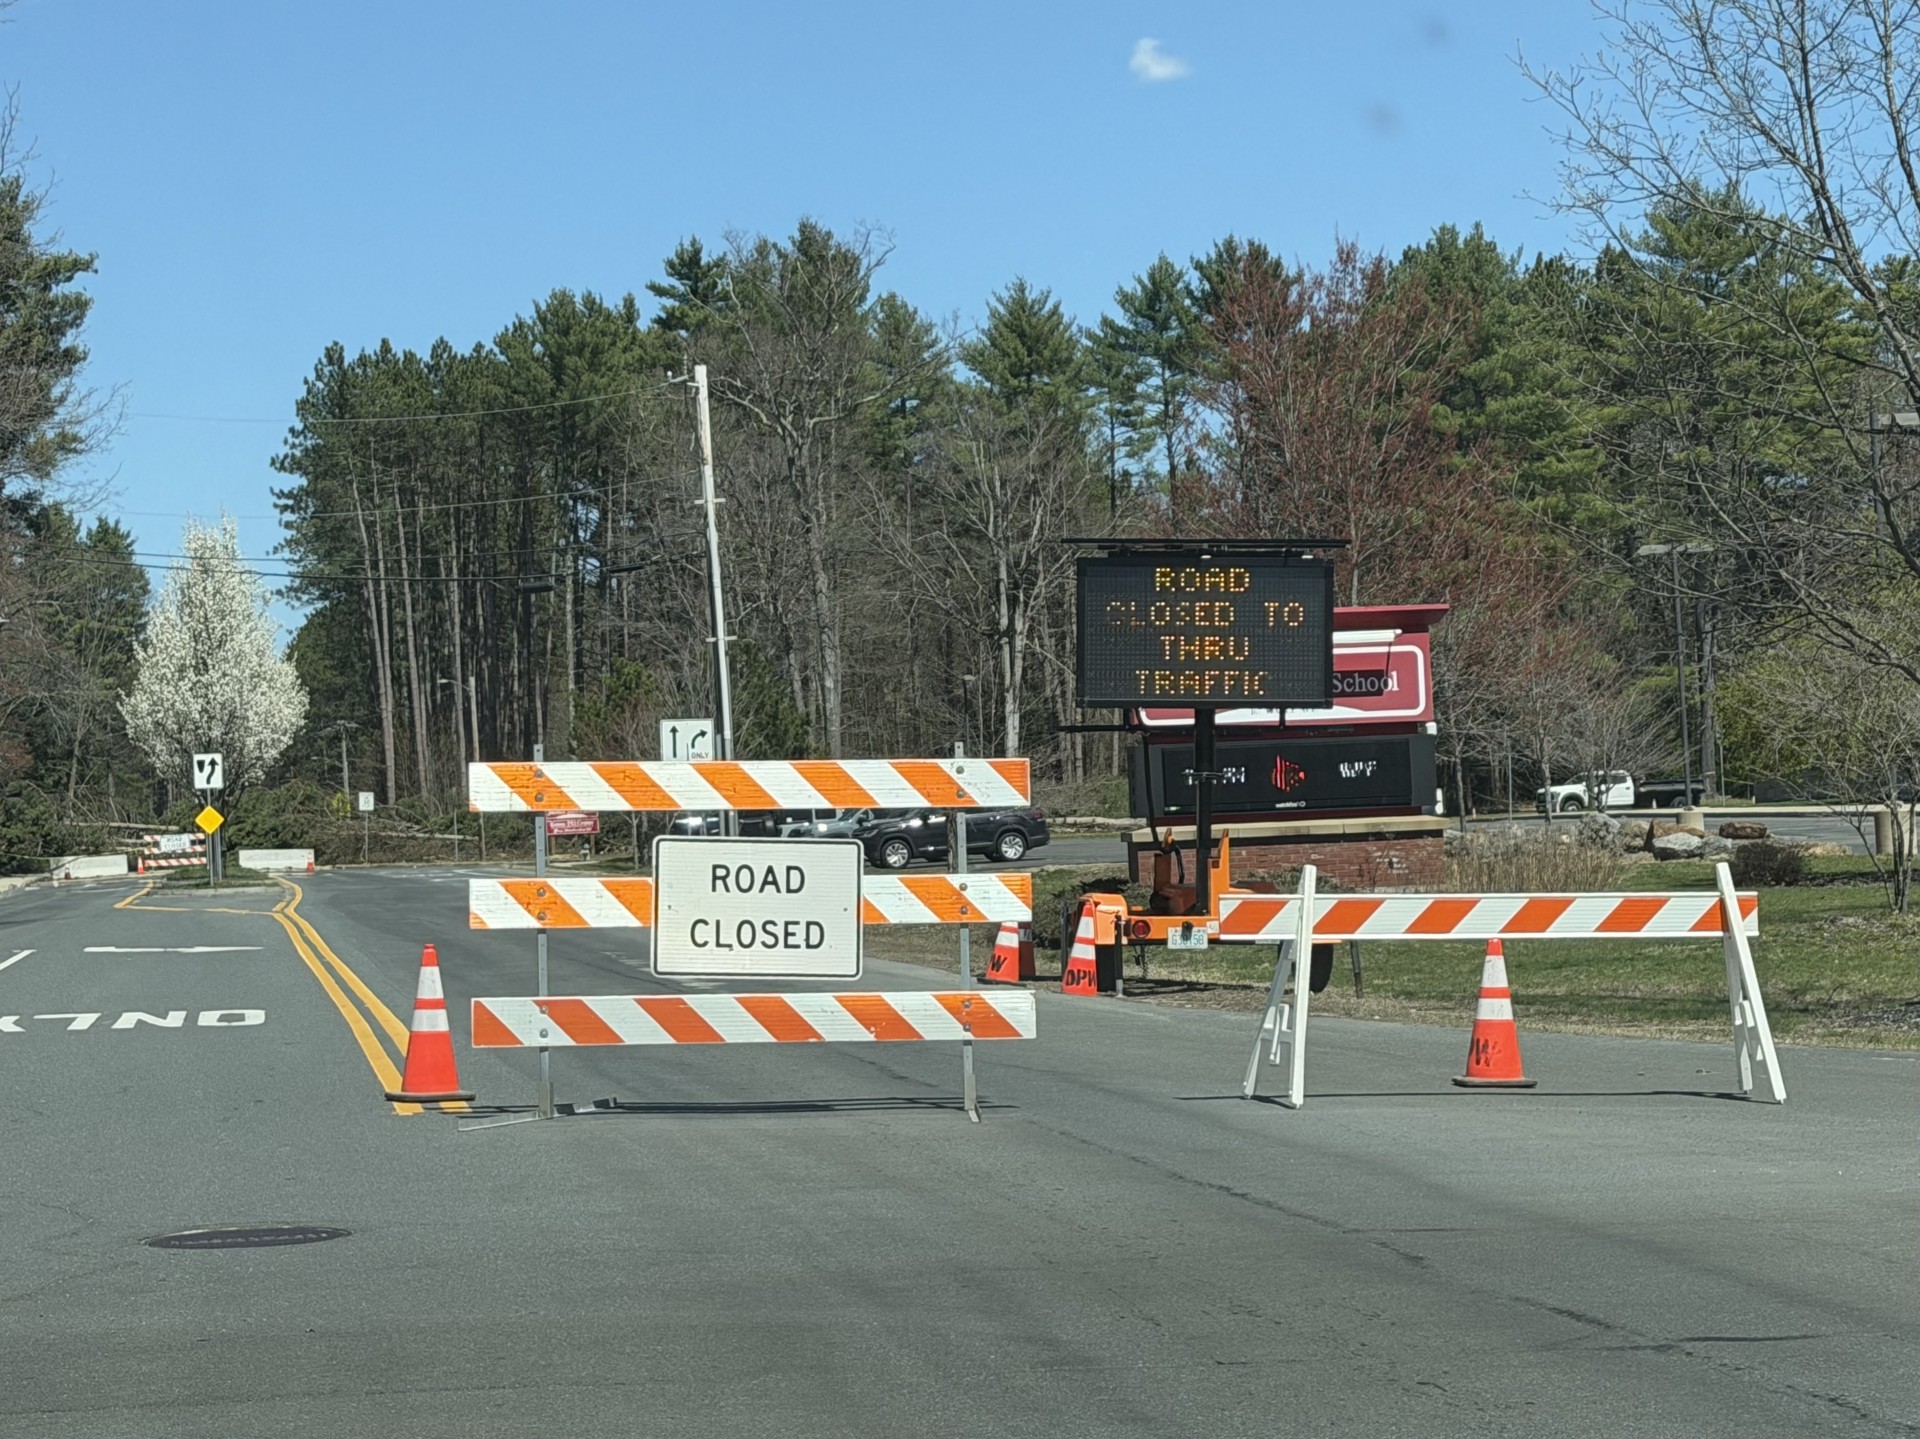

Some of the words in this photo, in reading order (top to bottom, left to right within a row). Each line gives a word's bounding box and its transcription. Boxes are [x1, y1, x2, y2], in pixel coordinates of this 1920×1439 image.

[1155, 567, 1250, 592] ROAD
[1106, 601, 1235, 626] CLOSED
[1263, 601, 1305, 627] TO
[1159, 635, 1250, 661] THRU
[1135, 670, 1270, 695] TRAFFIC
[1333, 670, 1400, 693] School
[711, 864, 806, 894] ROAD
[690, 919, 826, 949] CLOSED
[1172, 934, 1205, 946] G3158
